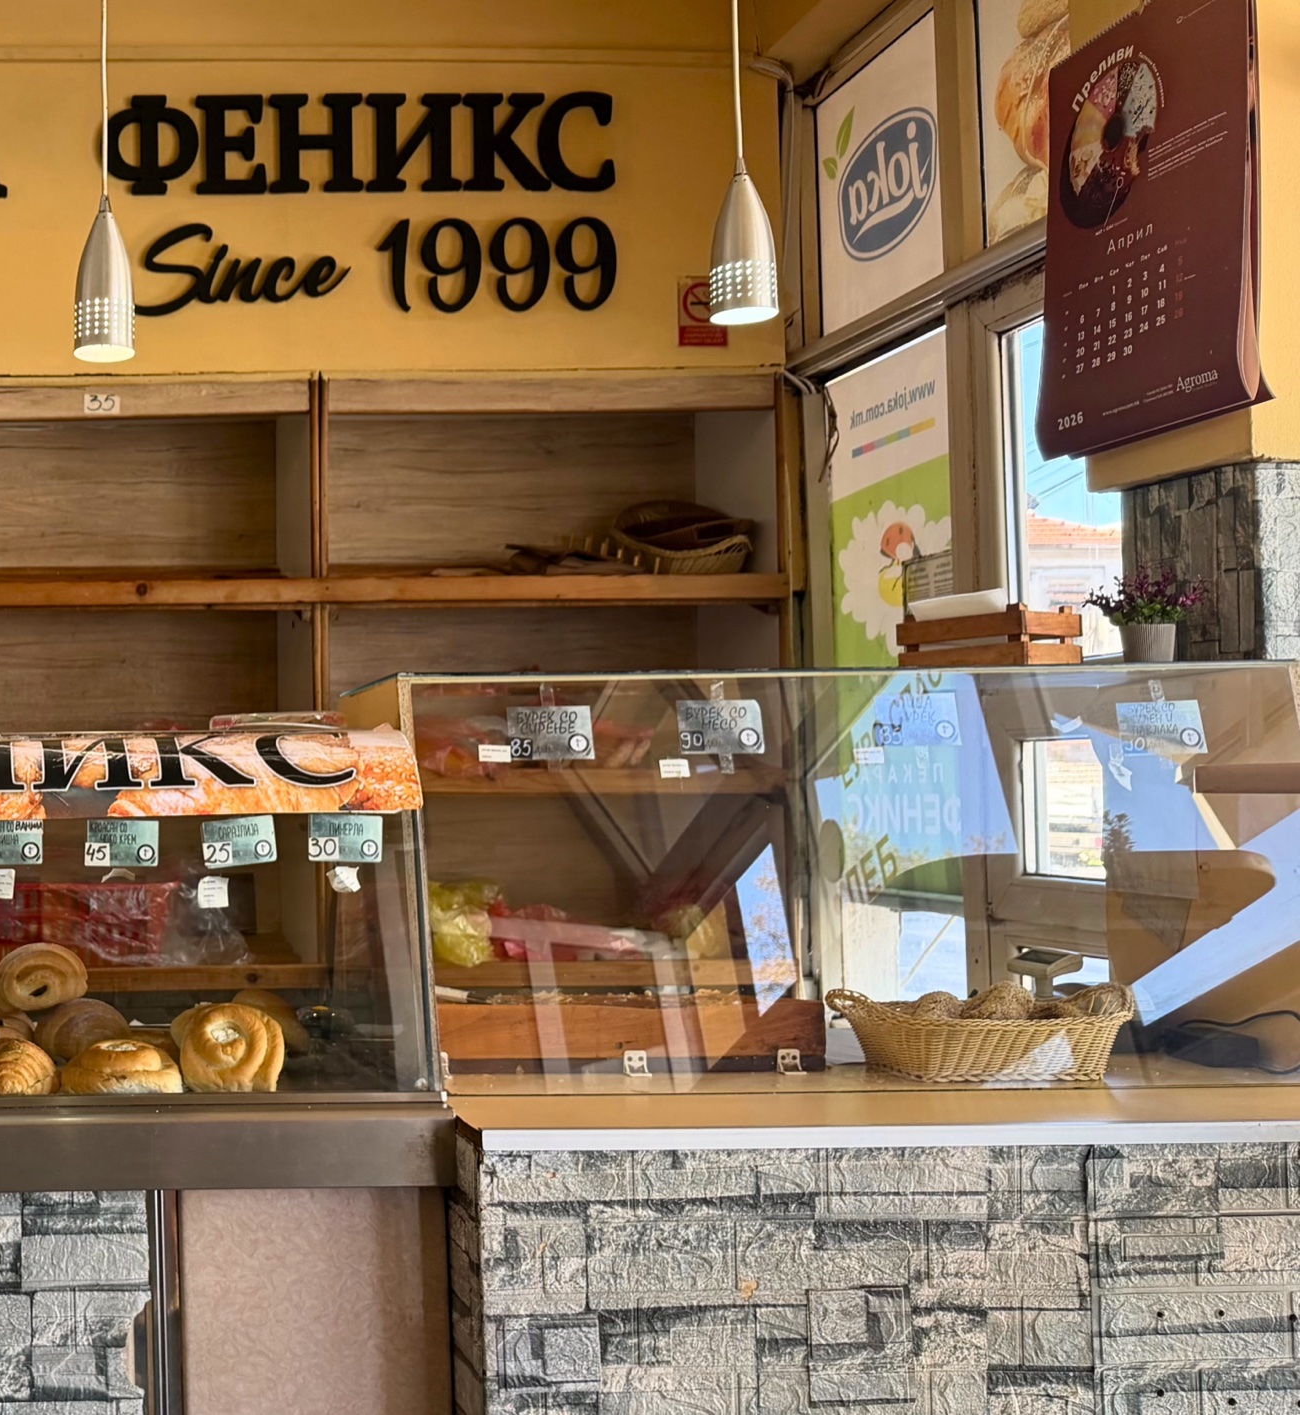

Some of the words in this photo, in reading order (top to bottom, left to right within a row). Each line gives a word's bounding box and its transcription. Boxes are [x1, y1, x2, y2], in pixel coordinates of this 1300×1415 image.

[1071, 45, 1134, 112] Преливи
[103, 91, 616, 196] ФЕНИКС
[1106, 224, 1154, 255] Април
[134, 223, 352, 317] Since
[377, 217, 617, 314] 1999
[1127, 278, 1133, 288] 2
[1143, 270, 1148, 281] 3
[1159, 263, 1165, 273] 4
[1080, 314, 1085, 324] 6
[1096, 307, 1101, 318] 7
[1111, 301, 1116, 311] 8
[1127, 294, 1132, 304] 9
[1141, 287, 1149, 298] 10
[1158, 279, 1167, 290] 11
[1077, 331, 1085, 342] 13
[1093, 324, 1101, 335] 14
[1109, 318, 1117, 329] 15
[1125, 311, 1133, 323] 16
[1141, 304, 1149, 315] 17
[1157, 298, 1165, 309] 18
[1076, 346, 1085, 358] 20
[1093, 340, 1101, 351] 21
[1108, 334, 1117, 346] 22
[1123, 328, 1133, 340] 23
[1139, 321, 1149, 333] 24
[1155, 314, 1166, 327] 25
[1076, 363, 1085, 374] 27
[1091, 356, 1101, 368] 28
[1107, 350, 1117, 362] 29
[1123, 344, 1133, 356] 30
[1176, 369, 1219, 393] Agroma
[87, 394, 116, 411] 35
[1057, 411, 1084, 431] 2026
[516, 711, 553, 725] БУРЕК
[558, 711, 578, 721] СО
[685, 706, 724, 722] БУРЕК
[729, 706, 747, 719] СО
[1161, 702, 1176, 713] СО
[520, 720, 576, 735] СИРЕЊЕ
[701, 718, 737, 731] МЕСО
[511, 739, 532, 758] 85
[680, 733, 703, 750] 90
[329, 822, 364, 836] ПИНЕРЛА
[86, 843, 107, 862] 45
[206, 842, 231, 864] 25
[308, 837, 337, 858] 30
